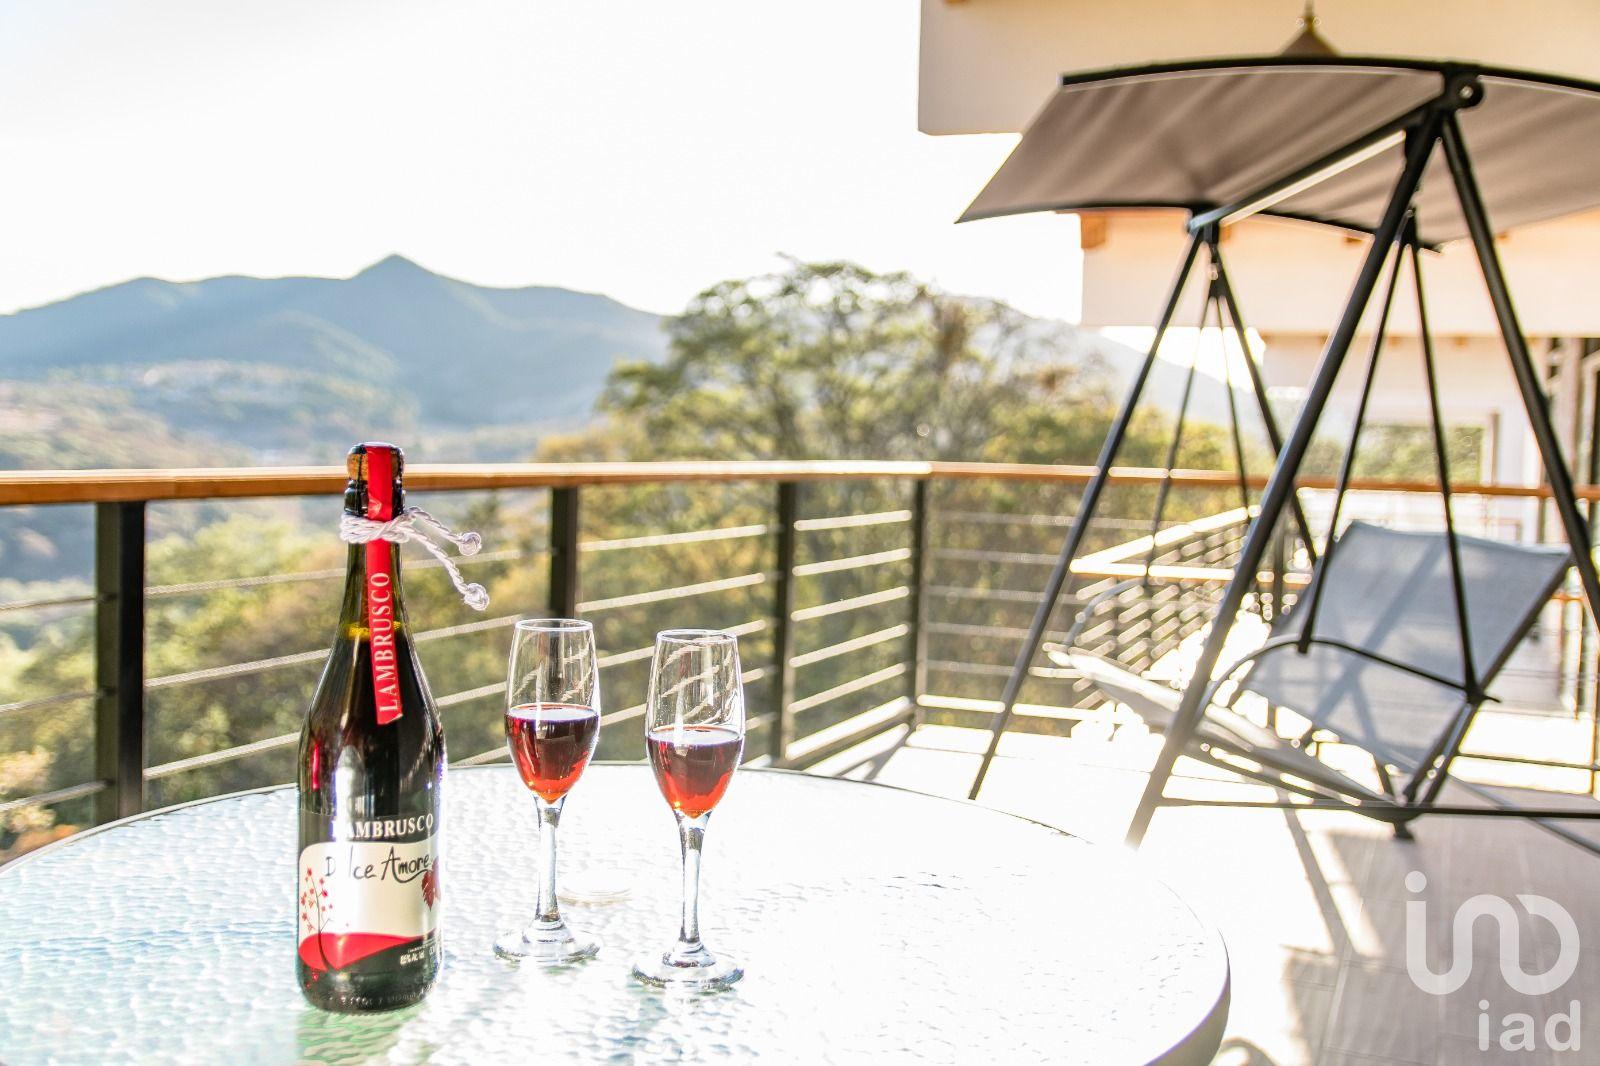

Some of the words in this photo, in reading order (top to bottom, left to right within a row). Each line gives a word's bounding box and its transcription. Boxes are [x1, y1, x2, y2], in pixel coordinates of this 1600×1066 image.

[370, 571, 400, 713] LAMBRUSCO
[325, 844, 377, 880] Dlce
[381, 846, 432, 884] Amore
